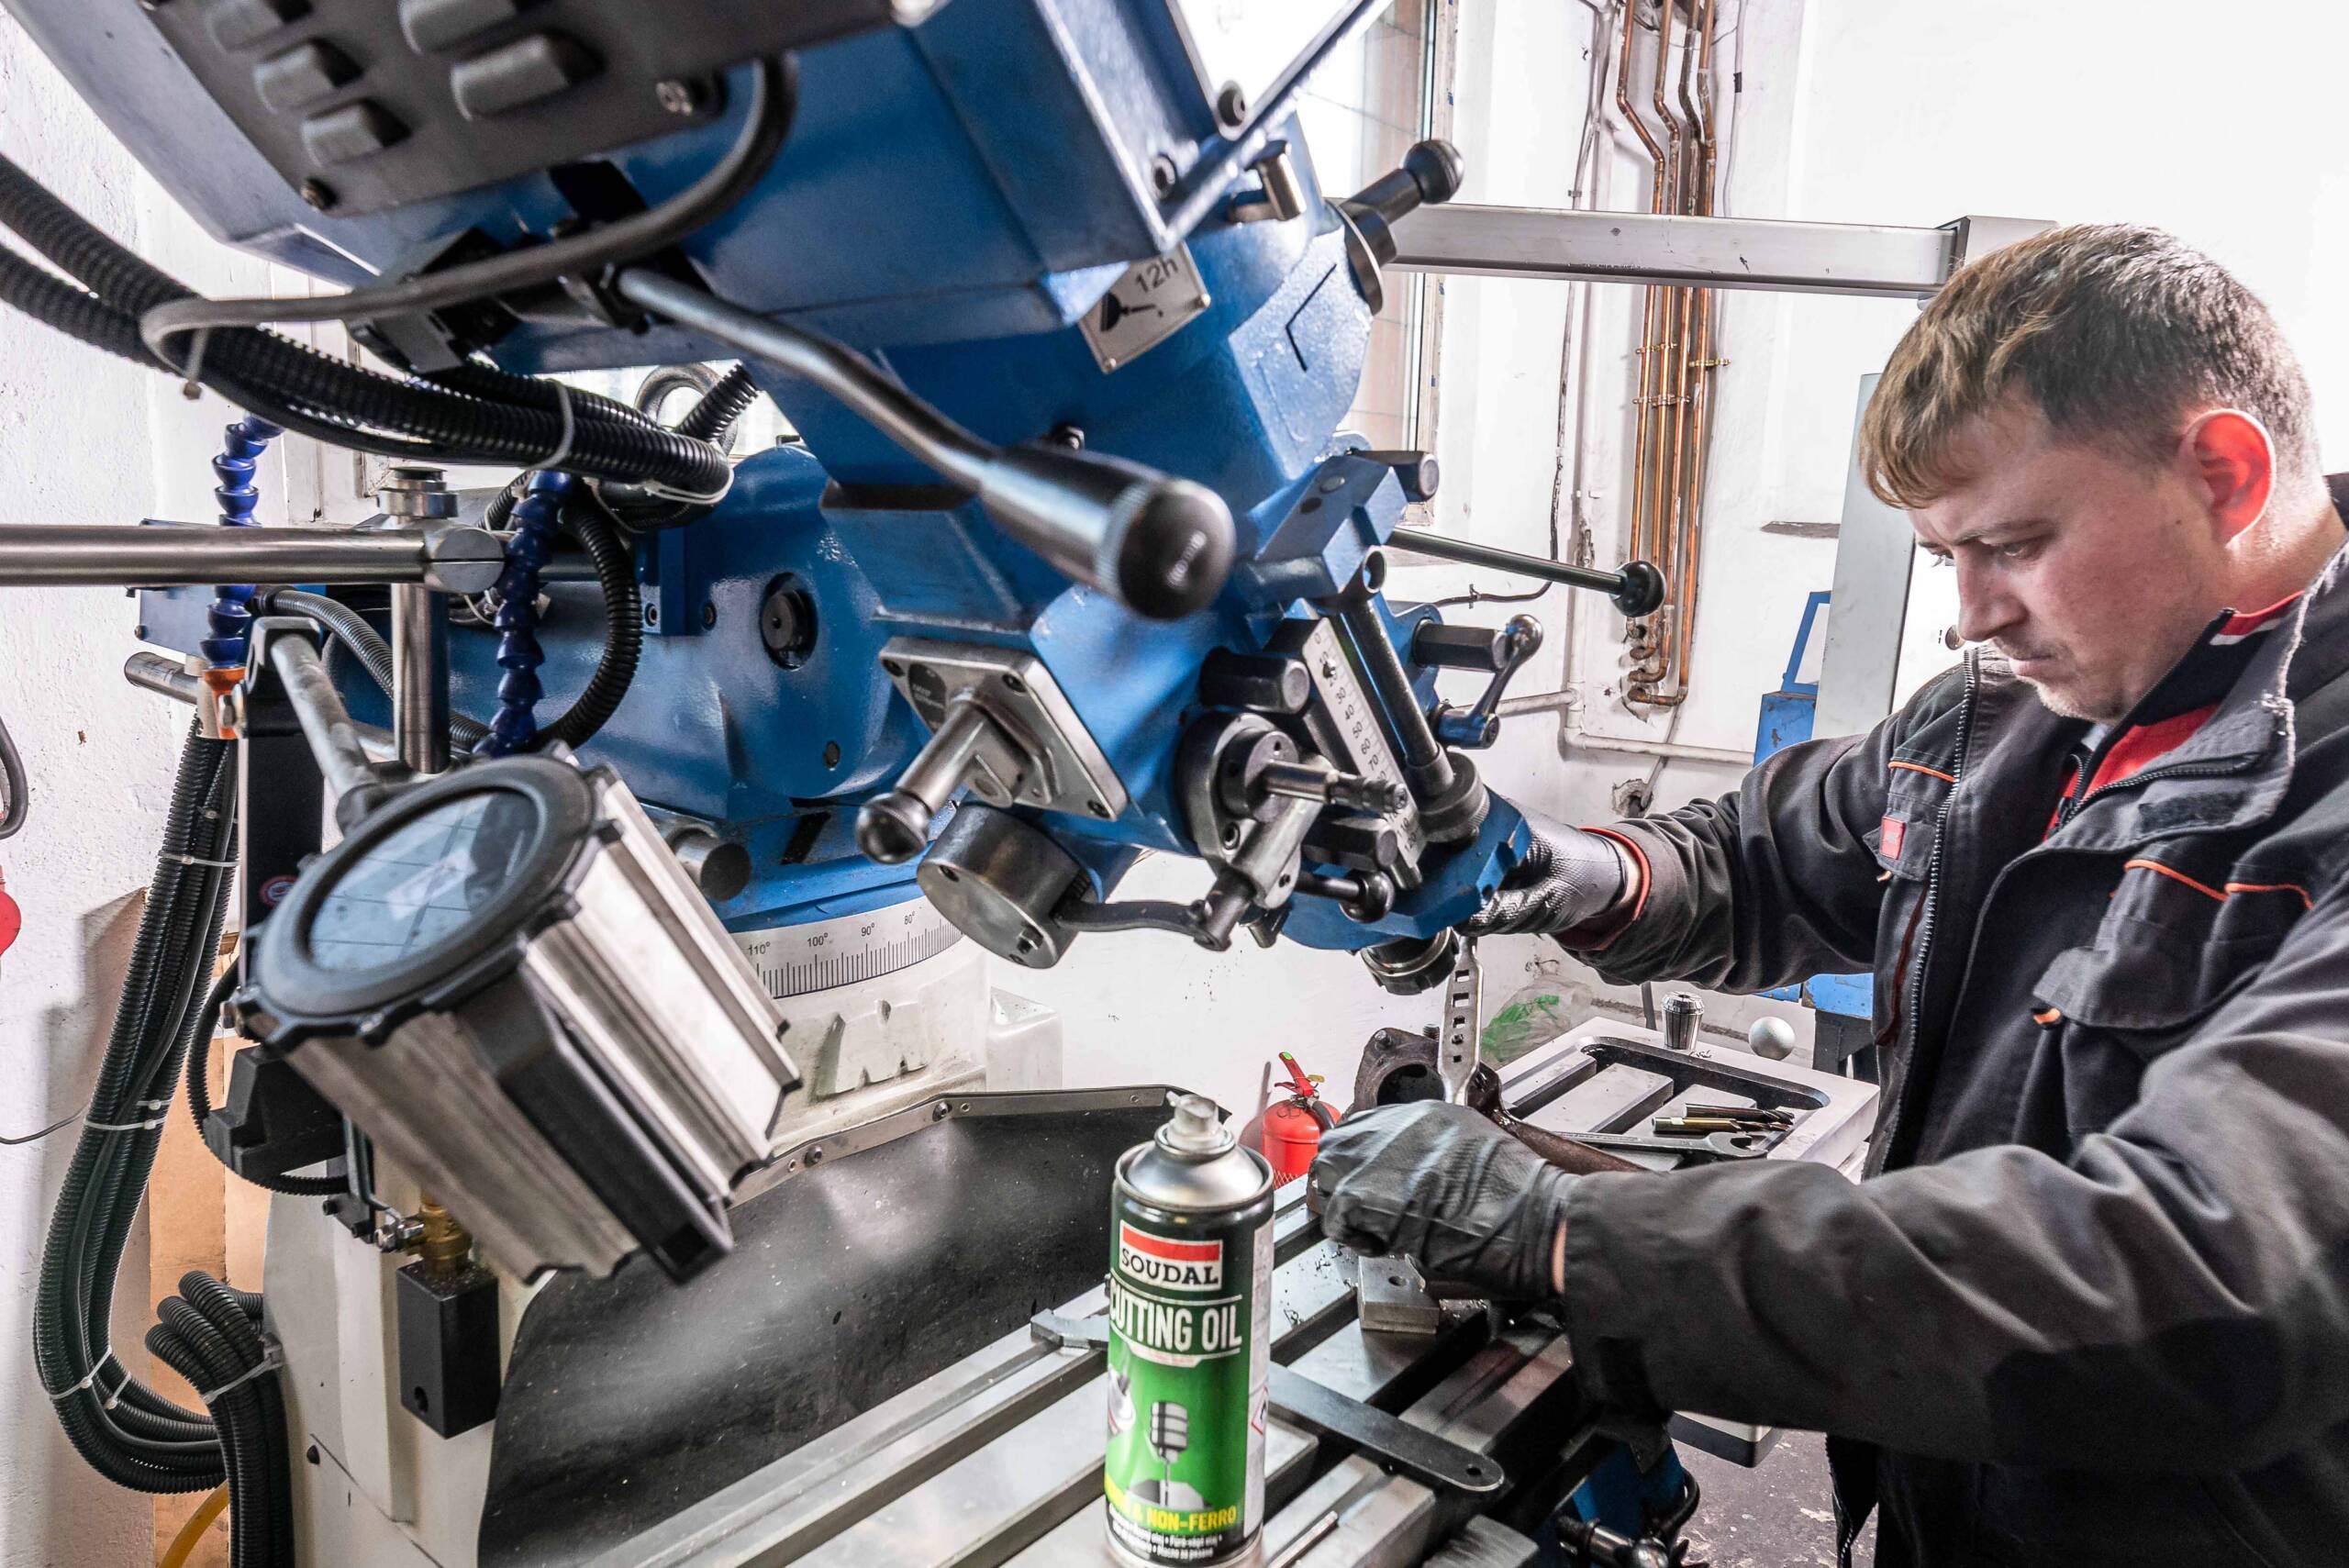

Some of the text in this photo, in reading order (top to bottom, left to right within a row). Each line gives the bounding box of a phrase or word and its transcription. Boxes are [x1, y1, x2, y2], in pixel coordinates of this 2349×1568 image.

[1135, 257, 1179, 294] 12h
[1336, 686, 1346, 705] 30
[1345, 704, 1354, 720] 40
[1353, 721, 1363, 739] 50
[1361, 738, 1371, 755] 60
[1368, 754, 1378, 771] 70
[1121, 1248, 1219, 1285] SOUDAL
[1109, 1276, 1193, 1351] CUTTING
[1201, 1305, 1242, 1351] OIL
[1146, 1506, 1237, 1532] NON-FERRO
